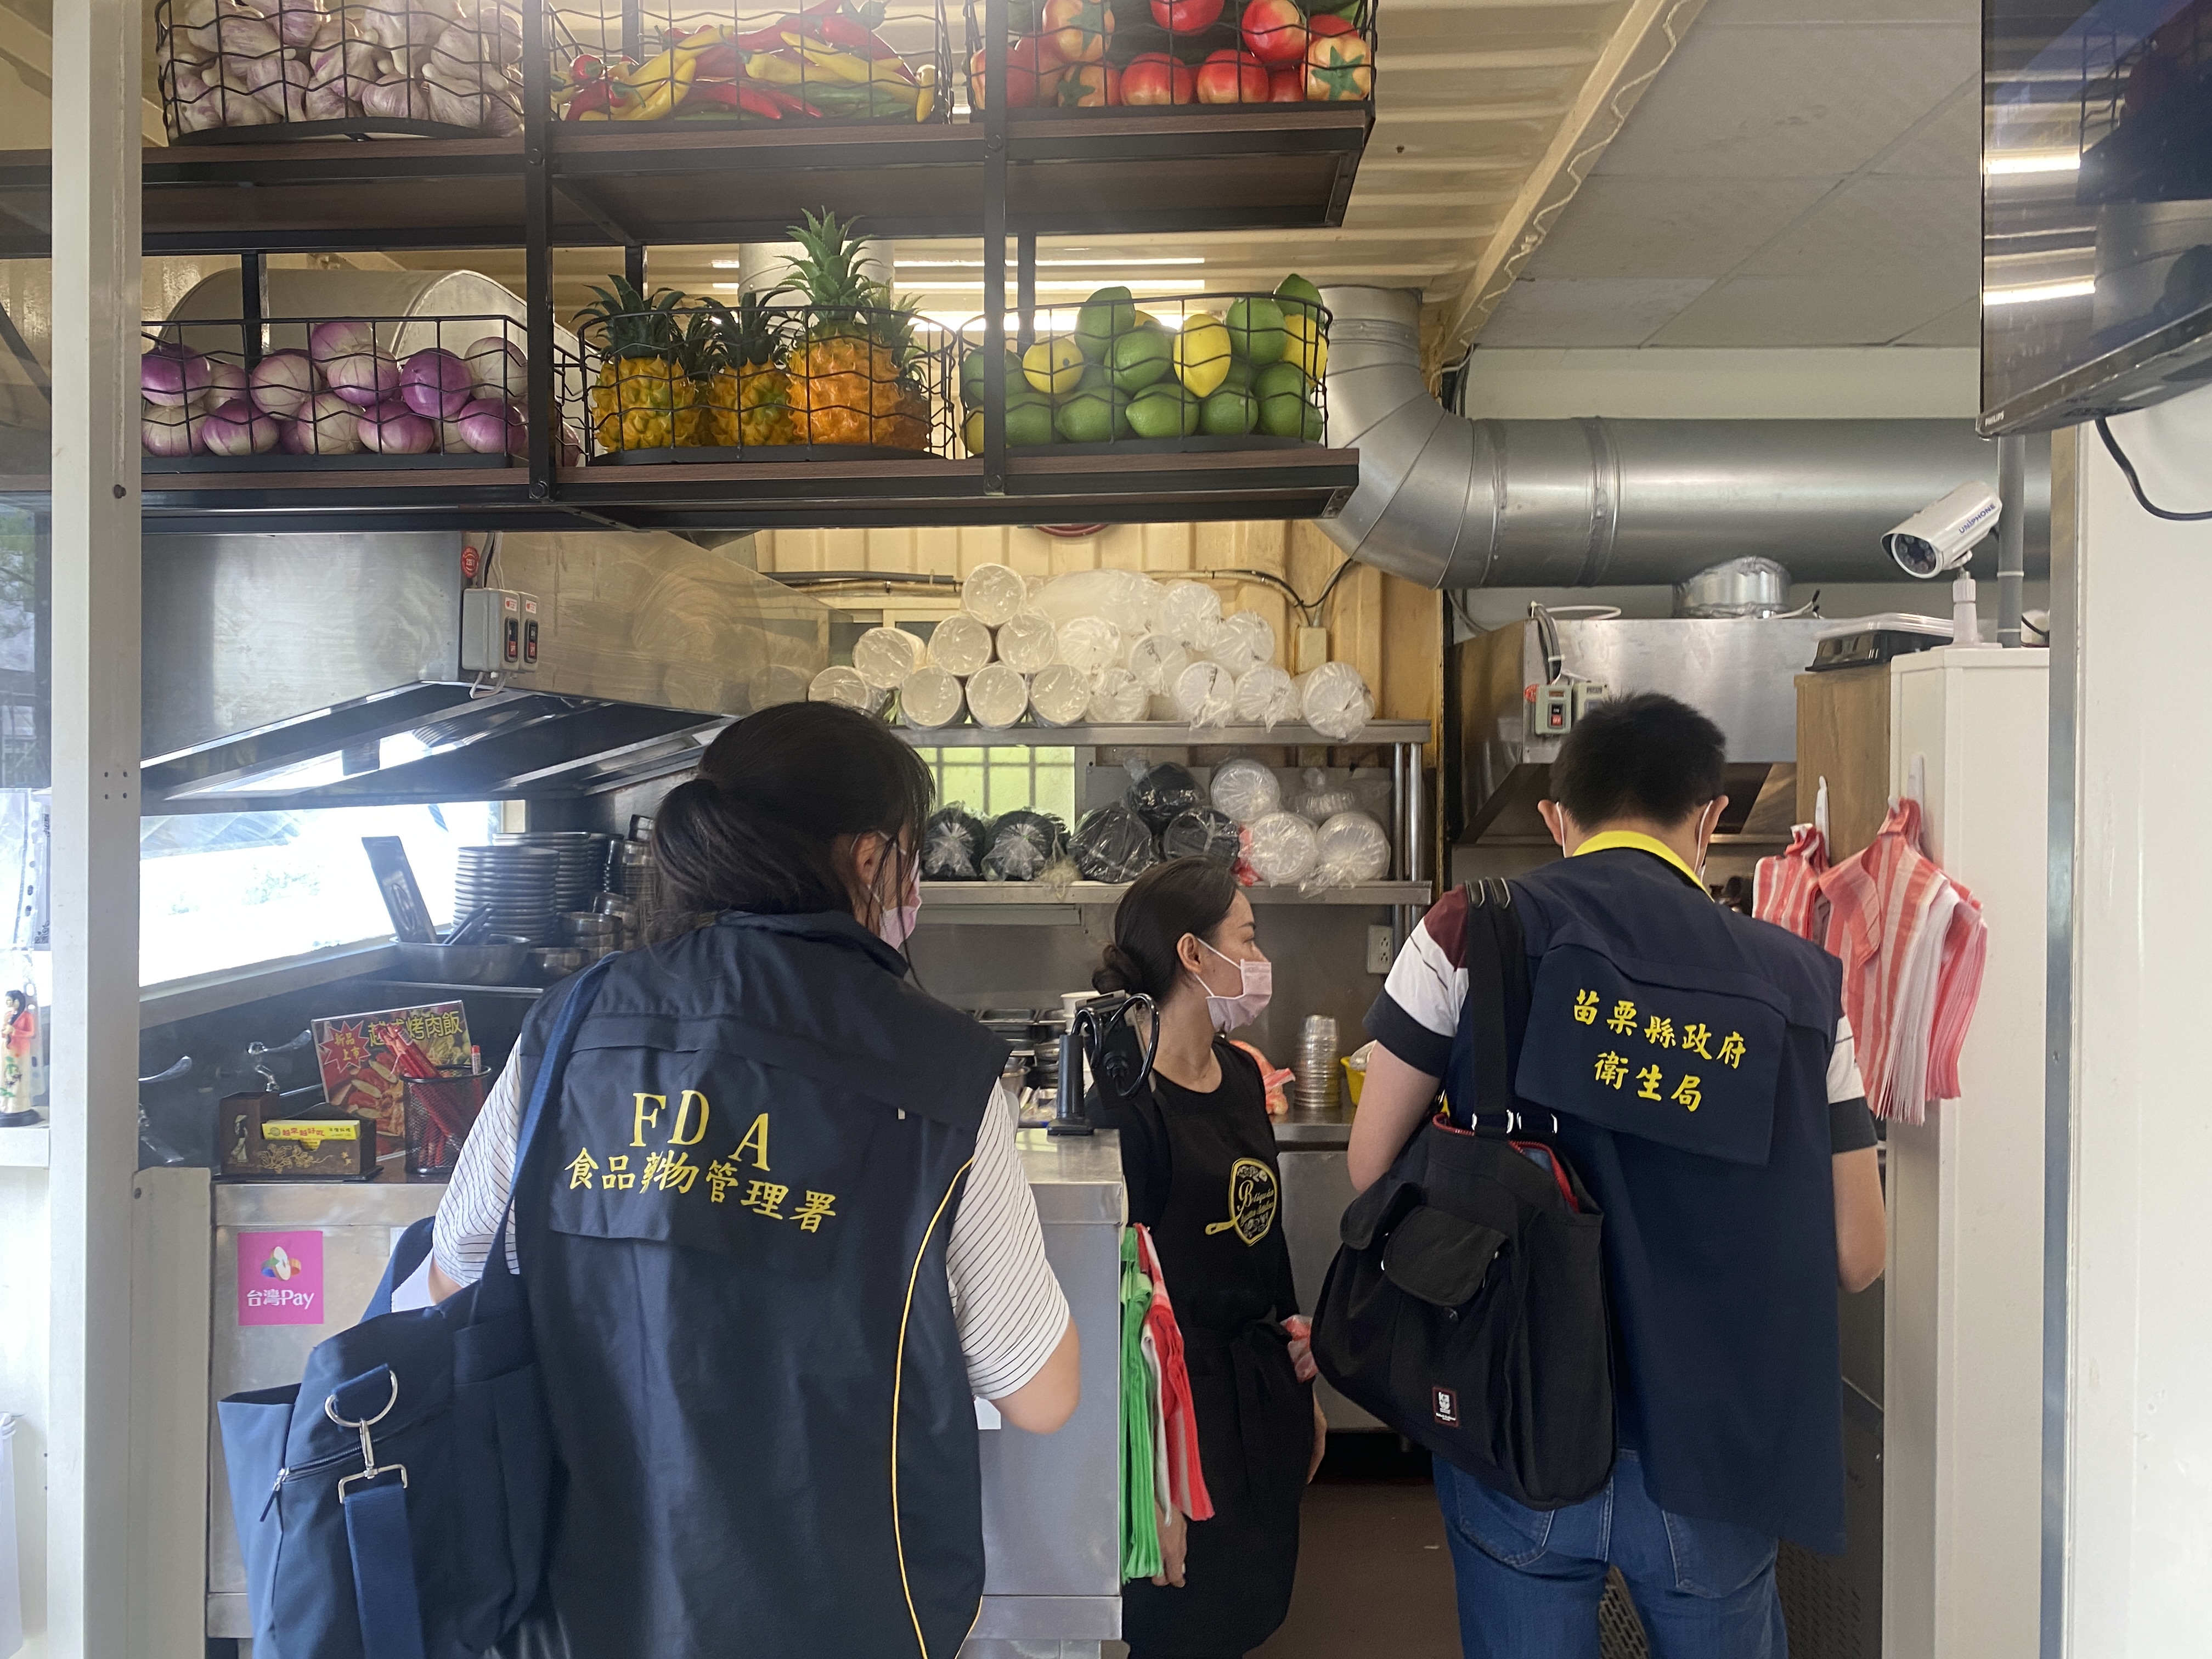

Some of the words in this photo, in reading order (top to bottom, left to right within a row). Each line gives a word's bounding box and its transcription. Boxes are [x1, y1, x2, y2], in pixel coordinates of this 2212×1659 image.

[1959, 503, 1996, 534] UNIPHONE
[334, 1032, 356, 1047] 新品
[1573, 989, 1746, 1069] 苗栗縣政府
[342, 1046, 360, 1061] 上市
[1594, 1051, 1702, 1112] 衛生局
[247, 1289, 314, 1310] 台灣Pay
